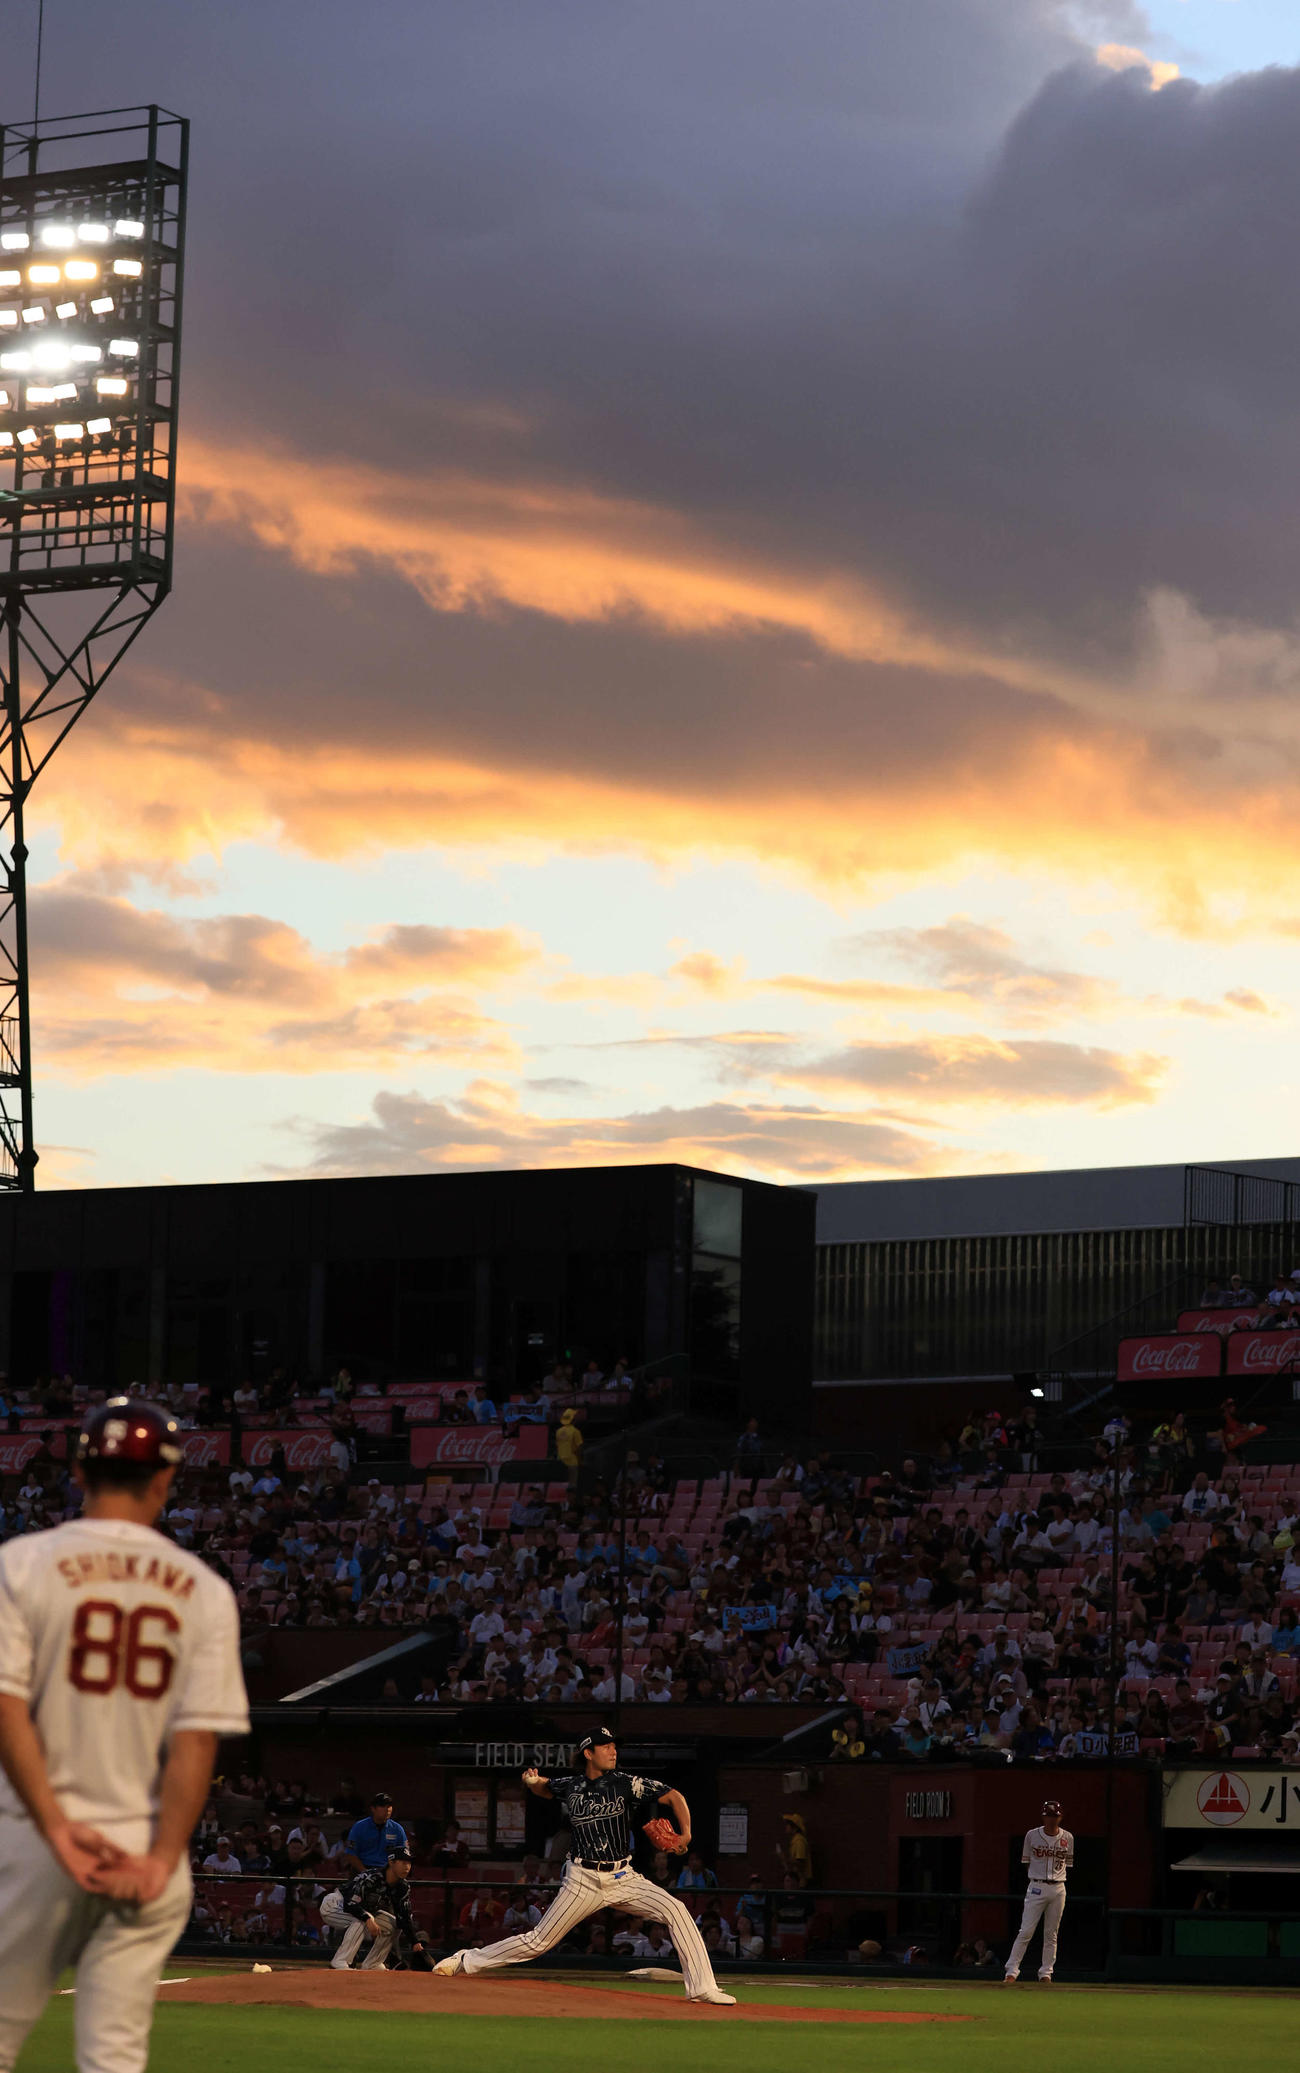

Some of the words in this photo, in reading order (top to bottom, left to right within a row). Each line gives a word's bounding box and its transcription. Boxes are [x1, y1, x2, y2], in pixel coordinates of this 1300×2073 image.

[69, 1600, 181, 1699] 86
[475, 1743, 524, 1768] FIELD
[568, 1793, 625, 1817] Lions
[1260, 1776, 1300, 1823] 小
[1032, 1847, 1068, 1859] EAGLES
